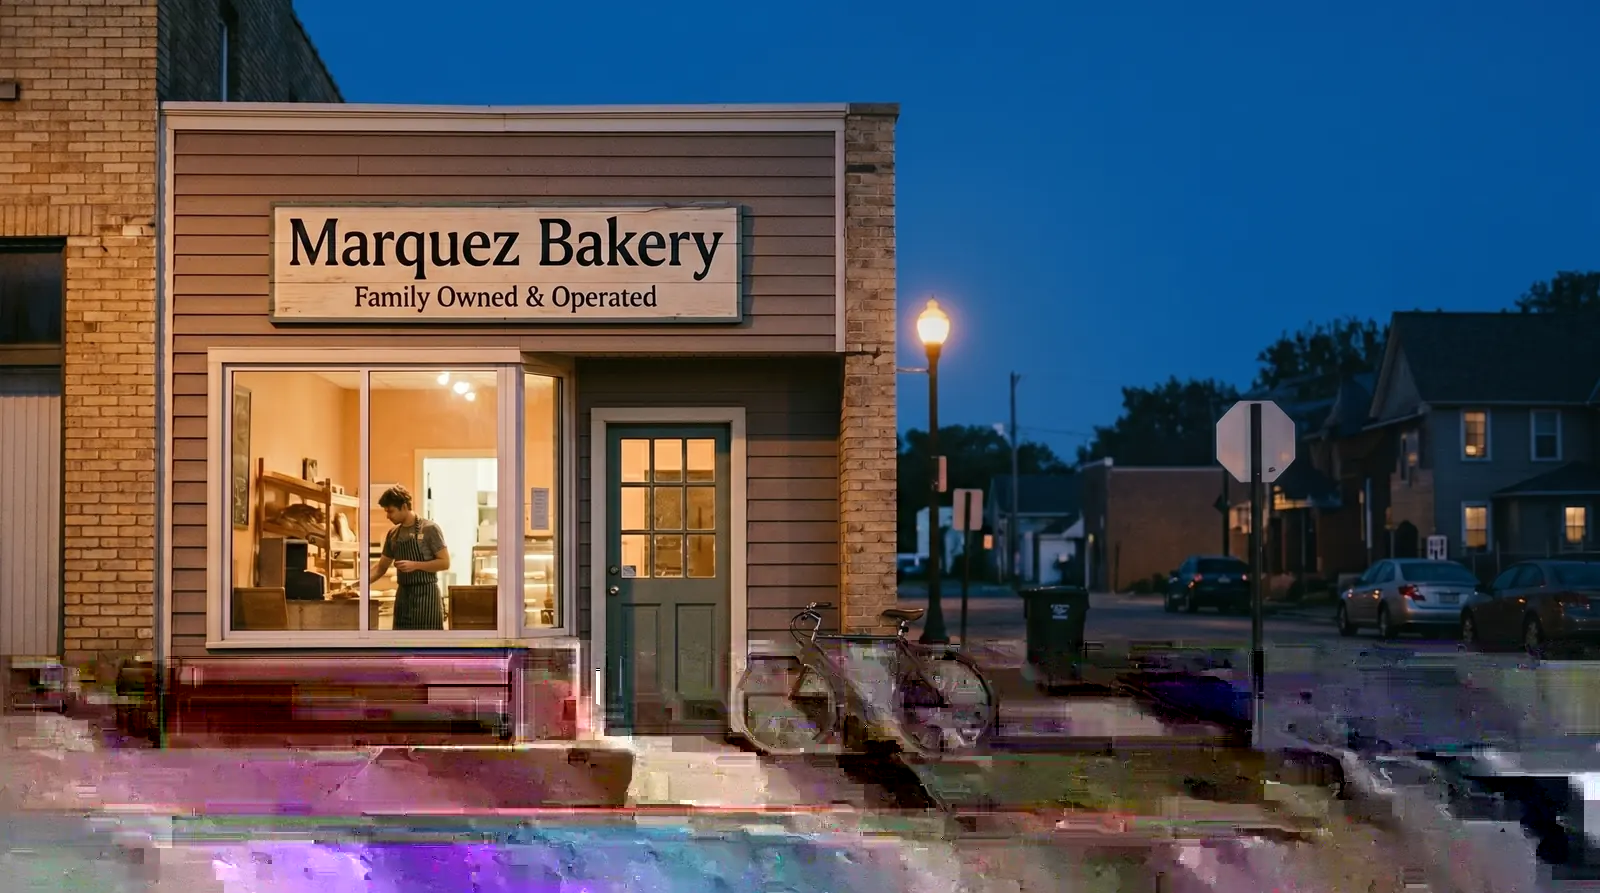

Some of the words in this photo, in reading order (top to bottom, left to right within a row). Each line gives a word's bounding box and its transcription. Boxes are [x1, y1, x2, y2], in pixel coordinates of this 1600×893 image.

[289, 218, 520, 280] Marquez
[538, 216, 724, 281] Bakery
[354, 285, 431, 314] Family
[437, 285, 519, 308] Owned
[525, 286, 545, 308] &
[551, 285, 658, 314] Operated
